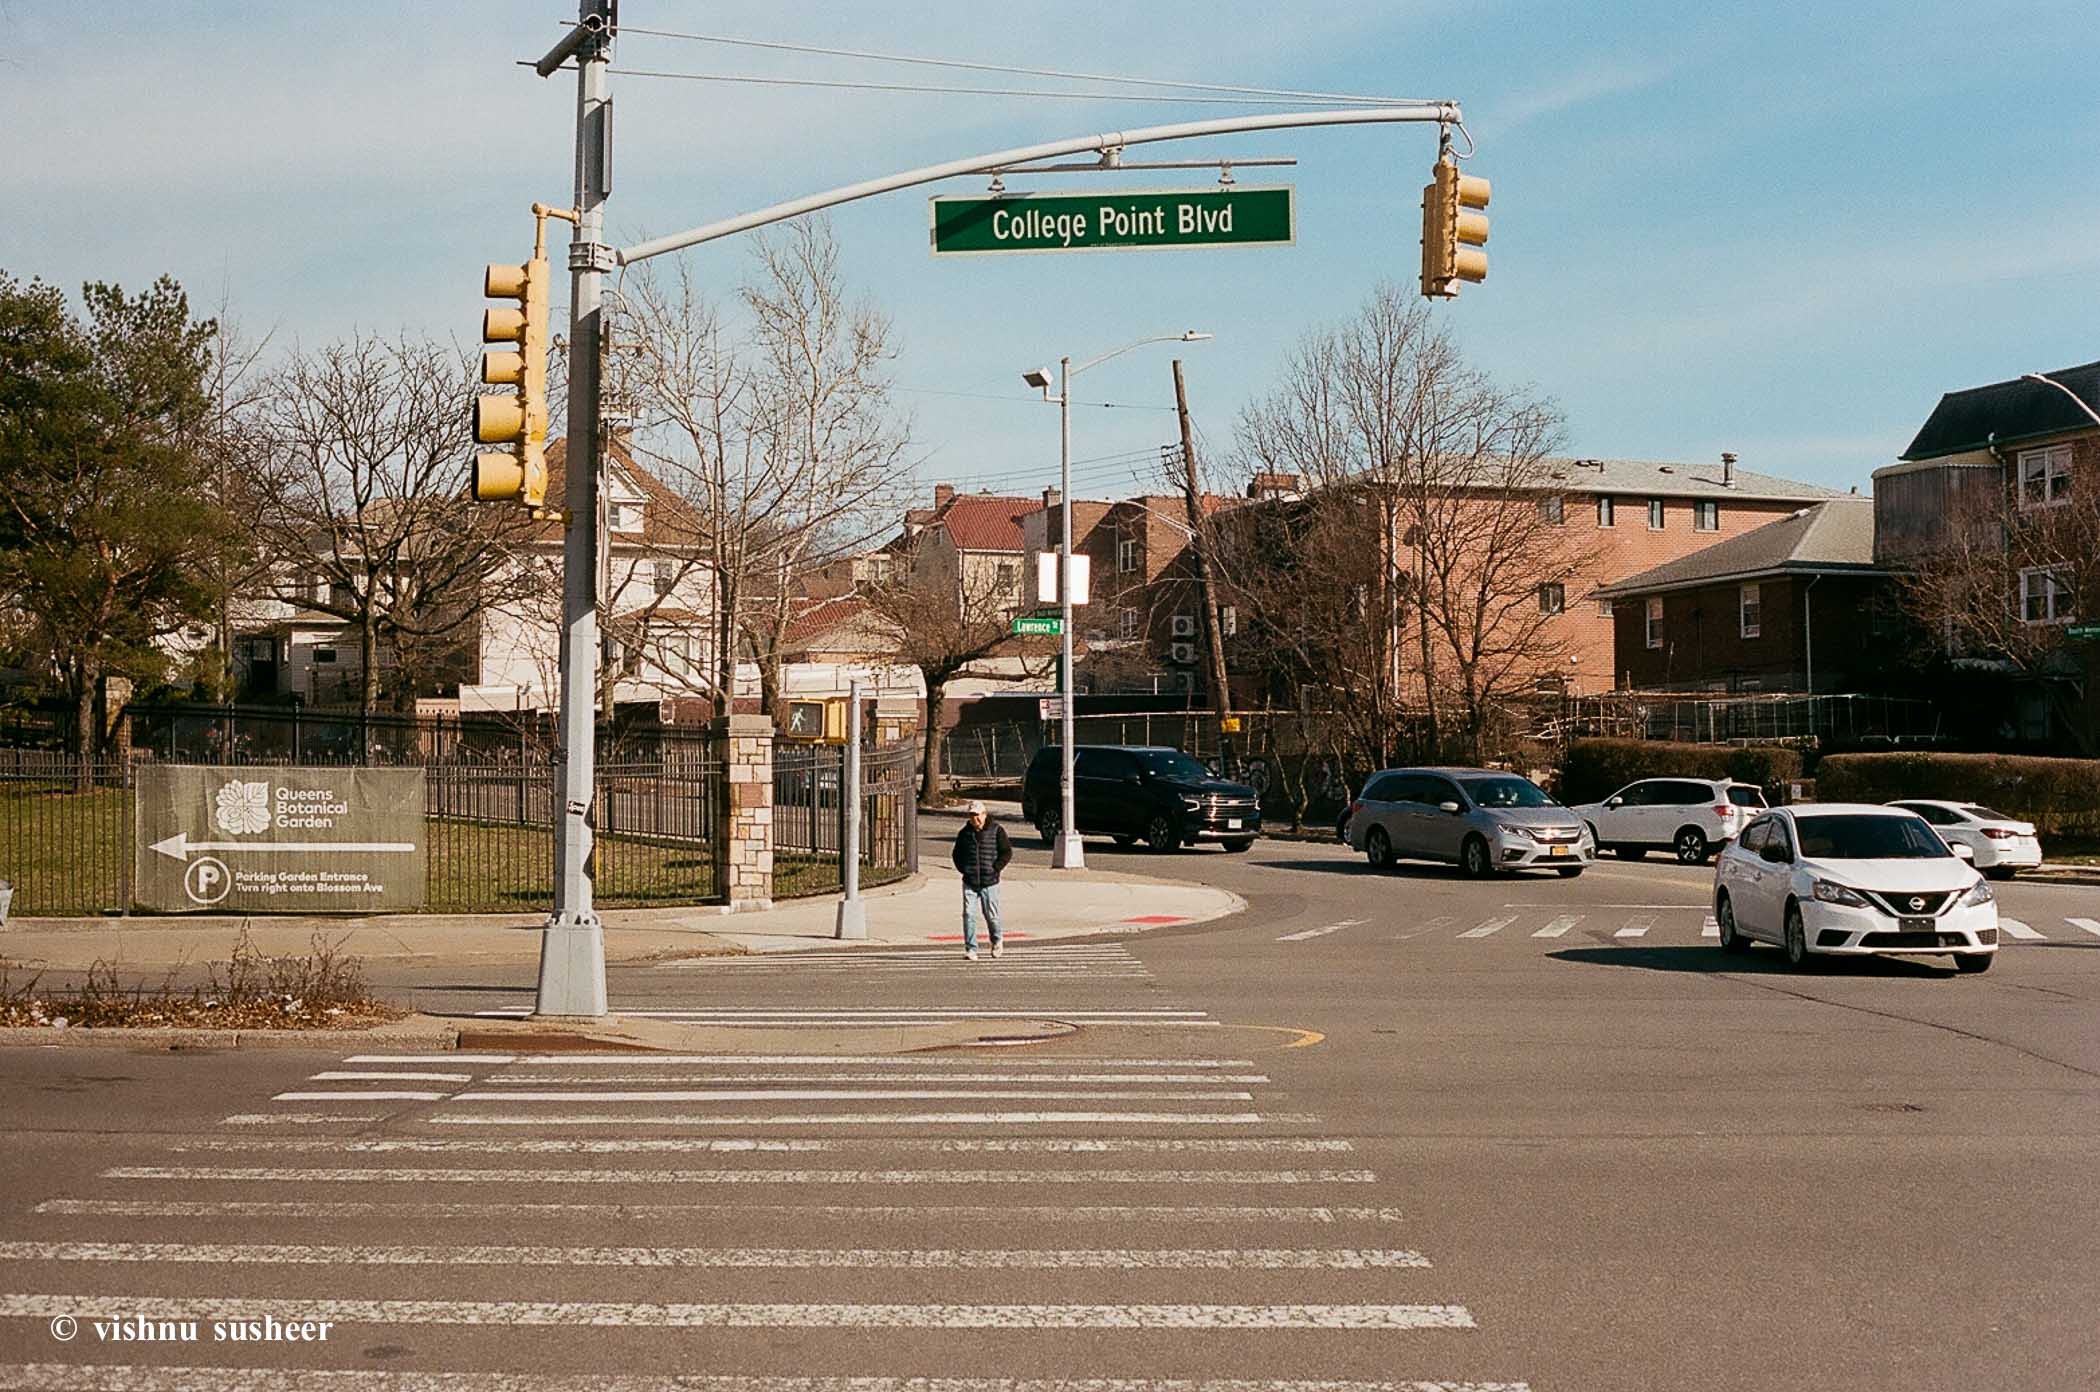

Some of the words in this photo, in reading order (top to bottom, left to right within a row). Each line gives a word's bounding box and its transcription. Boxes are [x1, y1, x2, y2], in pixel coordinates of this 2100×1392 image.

[993, 209, 1087, 246] College
[1099, 206, 1165, 236] Point
[1178, 204, 1233, 234] Blvd
[1017, 620, 1051, 633] Lawrence
[276, 787, 333, 802] Queens
[276, 801, 348, 814] Botanical
[276, 815, 333, 828] Garden
[198, 865, 220, 893] P
[236, 872, 276, 883] Parking
[279, 871, 317, 882] Garden
[320, 871, 368, 882] Entrance
[236, 883, 259, 892] Turn
[261, 883, 288, 895] right
[290, 883, 314, 892] onto
[317, 883, 361, 892] Blossom
[363, 883, 383, 892] Ave
